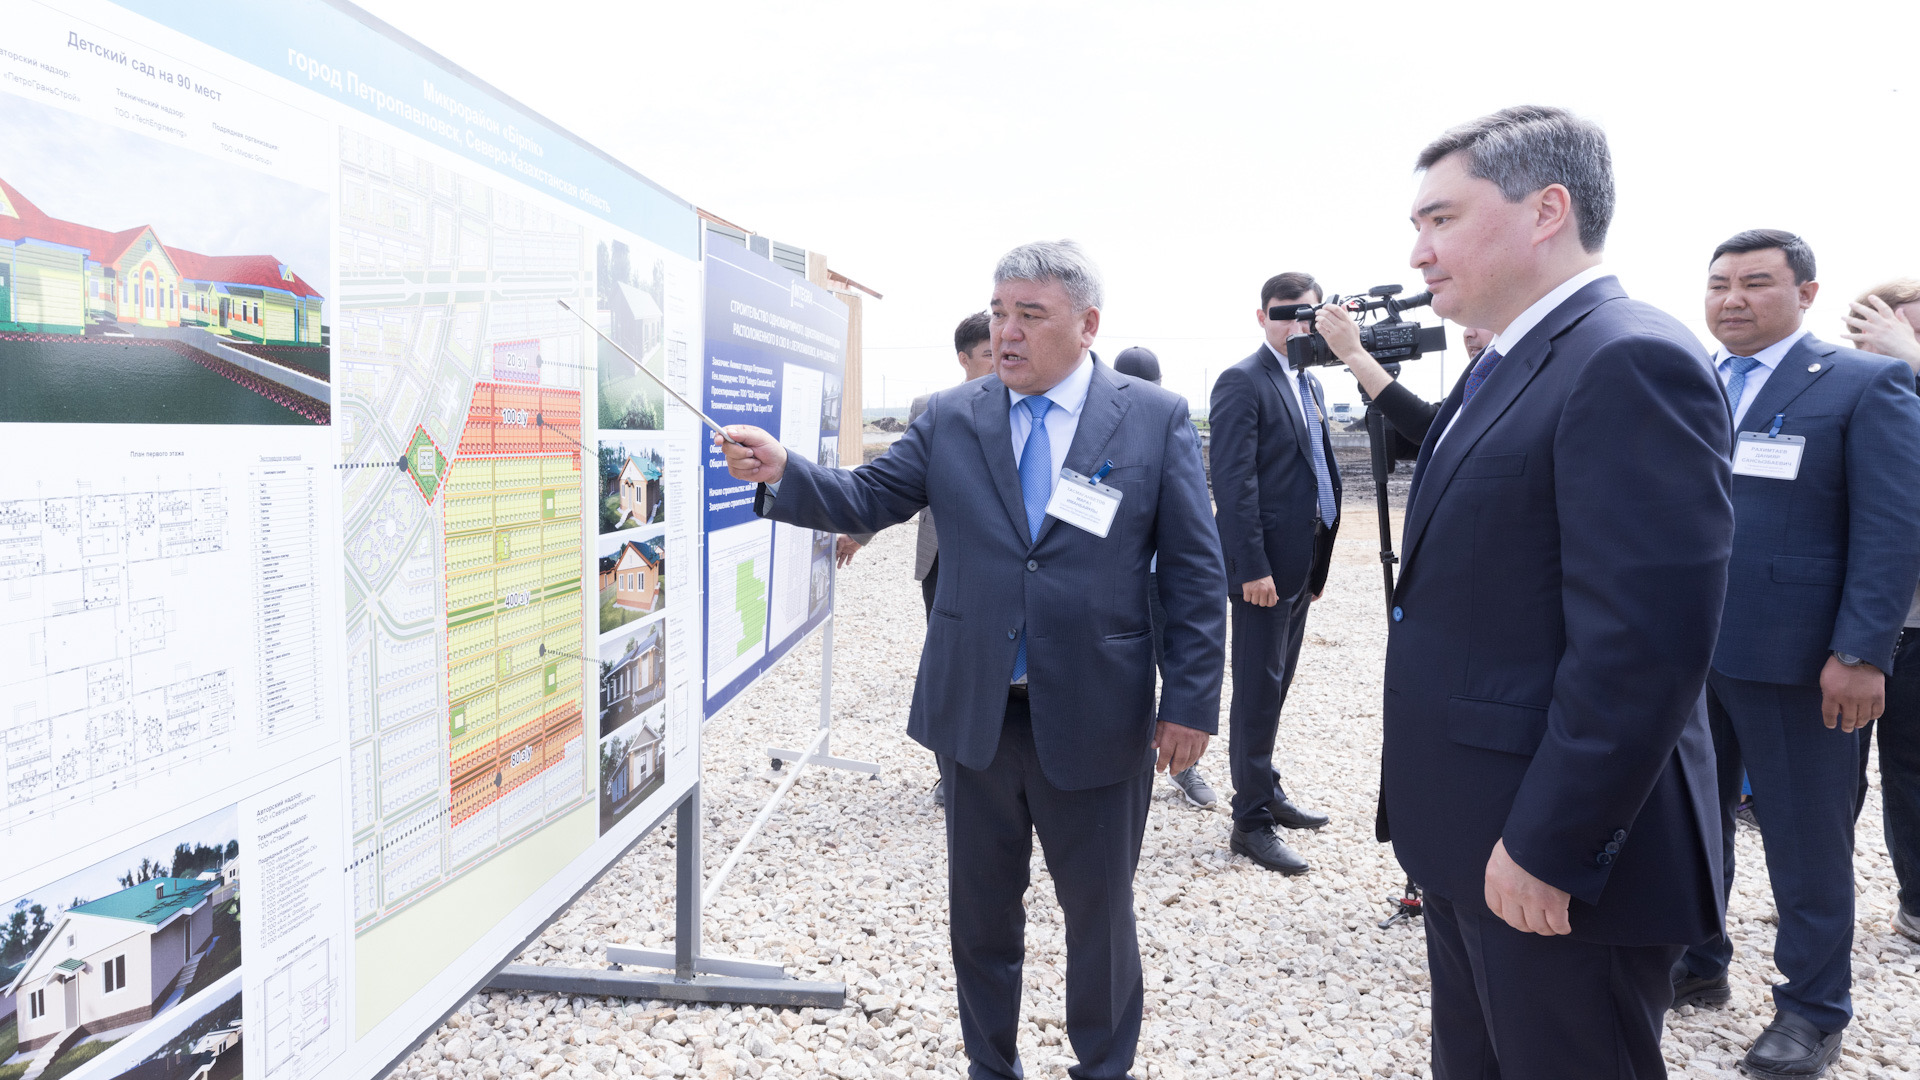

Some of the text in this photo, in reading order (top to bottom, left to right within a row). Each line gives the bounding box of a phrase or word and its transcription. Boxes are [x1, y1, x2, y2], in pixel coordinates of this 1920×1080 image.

[41, 59, 71, 79] надзор:
[67, 31, 222, 101] Детский сад на 90 мест
[116, 88, 186, 119] Технический надзор:
[423, 79, 544, 157] Микрорайон «Бірлік»
[212, 122, 243, 140] Подрядная
[288, 47, 611, 214] город Петропавловск, Северо-Казахстанская область
[731, 299, 768, 324] СТРОИТЕЛЬСТВО
[507, 354, 515, 367] 20
[503, 410, 516, 423] 100
[146, 451, 168, 459] первого
[505, 594, 518, 607] 400
[511, 754, 521, 767] 80
[256, 800, 284, 817] Авторский
[257, 822, 289, 842] Технический
